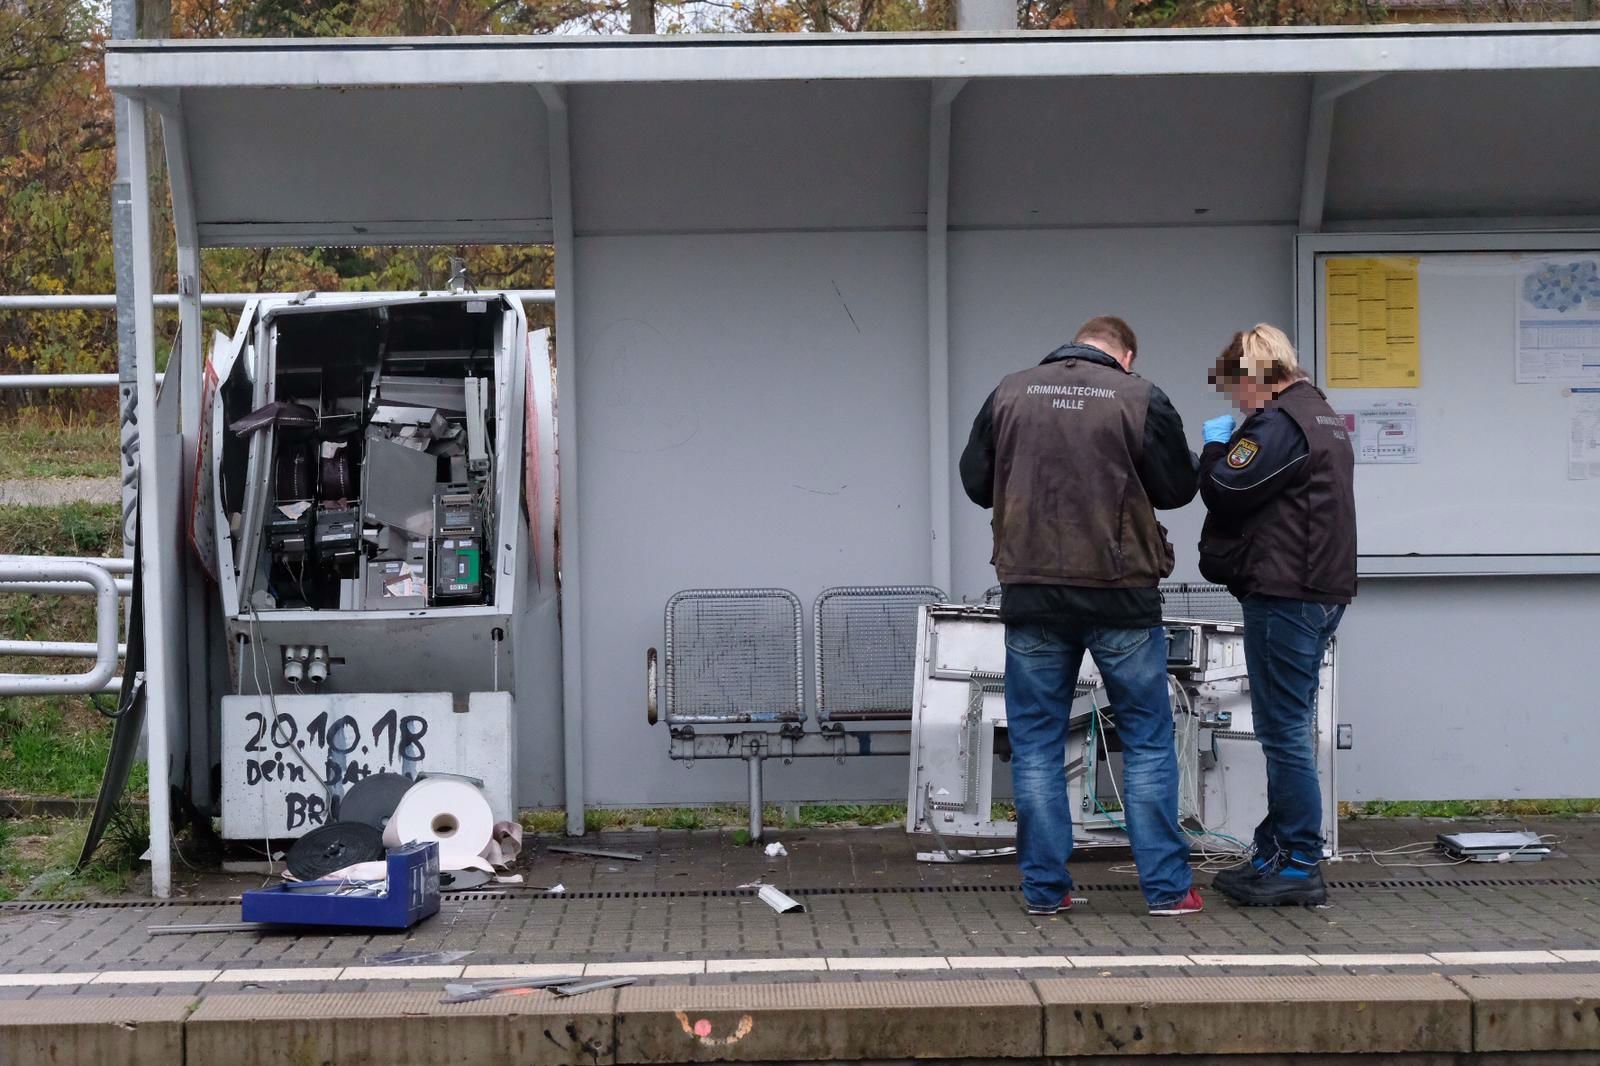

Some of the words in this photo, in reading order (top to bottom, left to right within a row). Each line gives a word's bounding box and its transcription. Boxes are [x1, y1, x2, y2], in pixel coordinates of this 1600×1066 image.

[1026, 384, 1116, 399] KRIMINALTECHNIK
[1052, 398, 1085, 410] HALLE
[244, 708, 429, 767] 20.10.18
[245, 751, 306, 786] Dein
